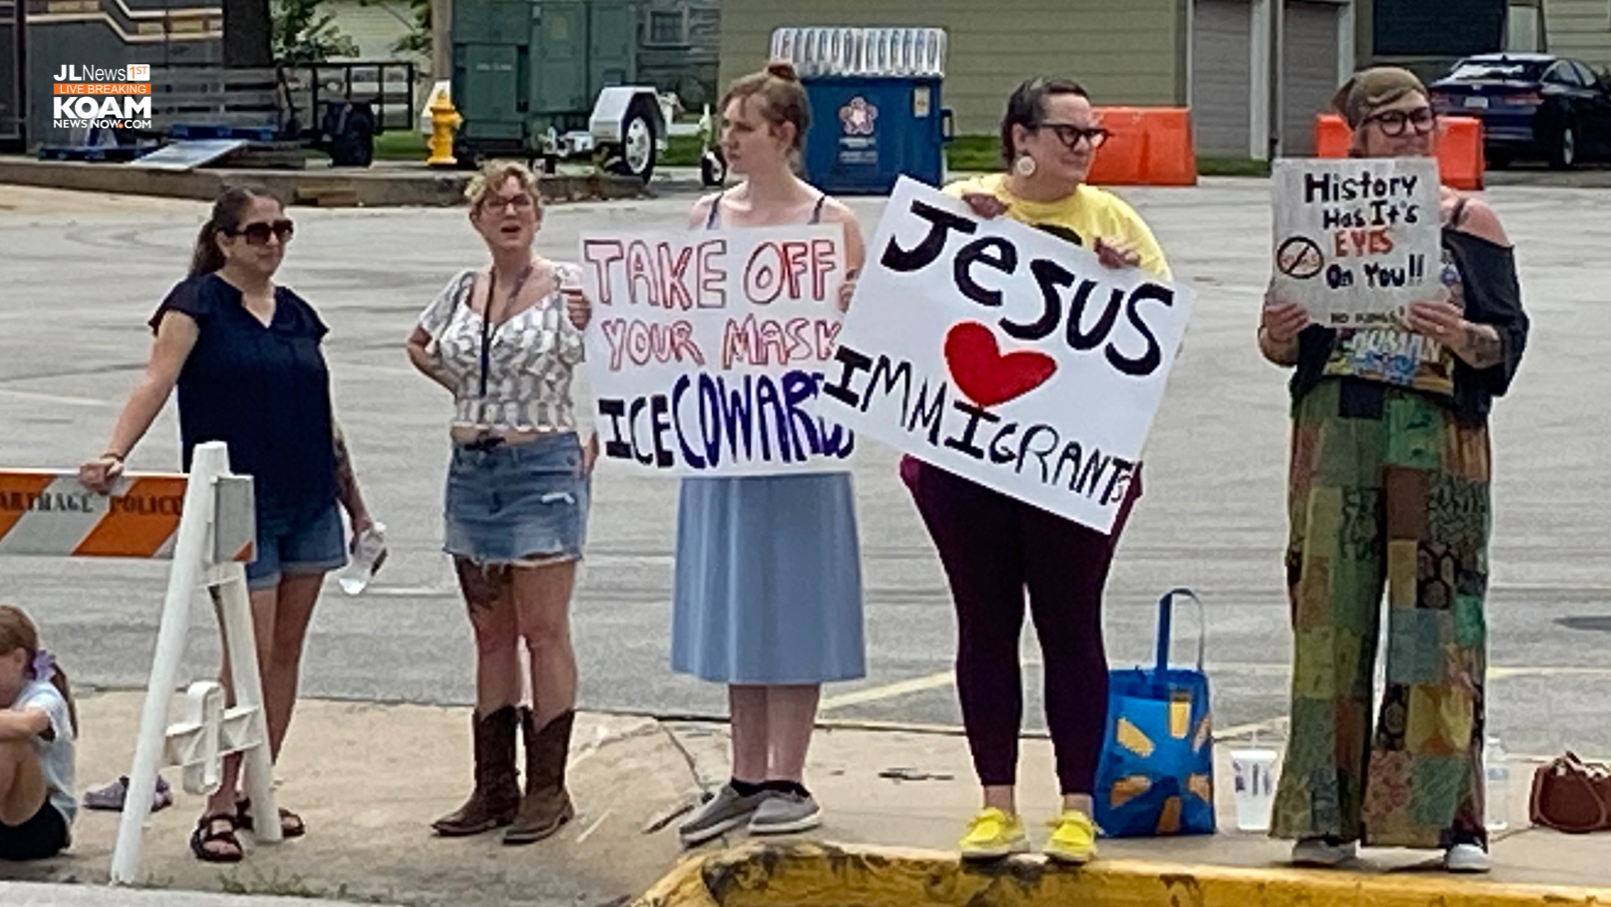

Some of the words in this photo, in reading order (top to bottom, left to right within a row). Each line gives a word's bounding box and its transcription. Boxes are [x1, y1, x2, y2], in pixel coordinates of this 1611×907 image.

[1304, 171, 1417, 203] History
[1334, 227, 1393, 257] EYES
[584, 239, 727, 310] TAKE
[744, 239, 836, 304] OFF
[1326, 263, 1354, 289] On
[601, 317, 704, 371] YOUR
[722, 313, 842, 370] MASK
[598, 394, 674, 468] ICE
